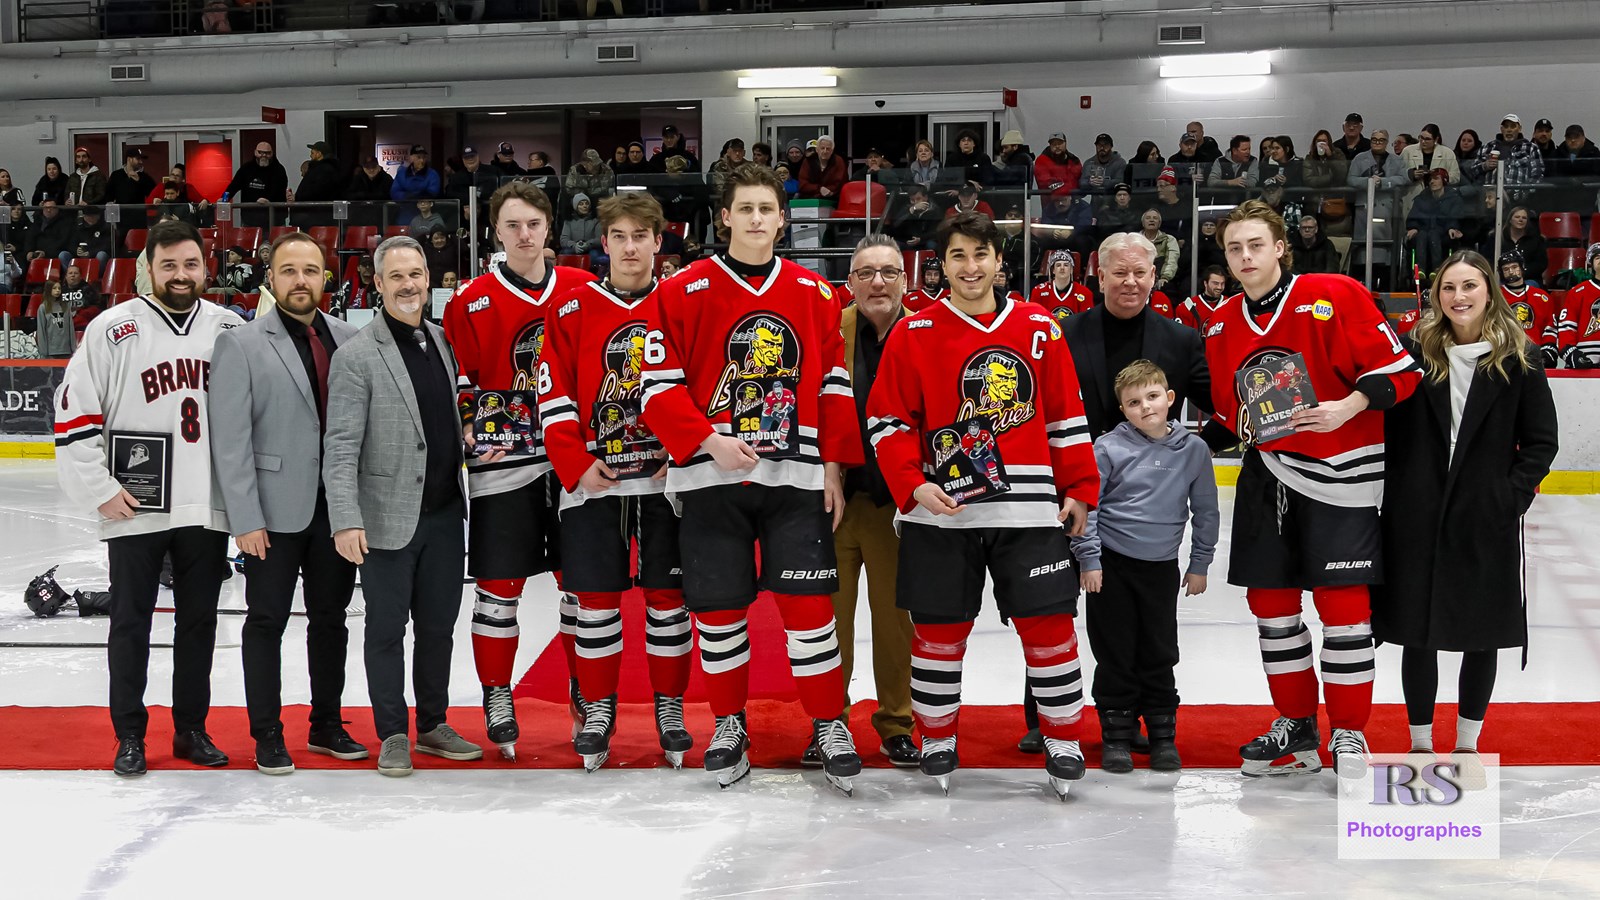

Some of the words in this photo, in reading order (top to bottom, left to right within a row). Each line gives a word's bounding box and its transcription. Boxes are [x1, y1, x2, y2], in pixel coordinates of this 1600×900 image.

[1261, 287, 1283, 306] CCM
[1314, 305, 1332, 317] NAPA
[644, 330, 666, 364] 6
[1031, 330, 1047, 360] C
[742, 360, 767, 375] Les
[0, 390, 40, 411] DE
[977, 396, 1003, 411] Les
[1259, 400, 1275, 414] 11
[181, 397, 201, 443] 8
[485, 421, 496, 433] 8
[740, 417, 760, 431] 26
[477, 433, 521, 441] ST-LOUIS
[737, 431, 781, 441] BEAUDIN
[606, 440, 623, 454] 18
[605, 450, 654, 464] ROCHEFOR
[949, 464, 960, 478] 4
[944, 475, 974, 491] SWAN
[1029, 559, 1070, 578] BAUER
[1325, 560, 1373, 570] BAUER
[780, 569, 837, 580] BAUER
